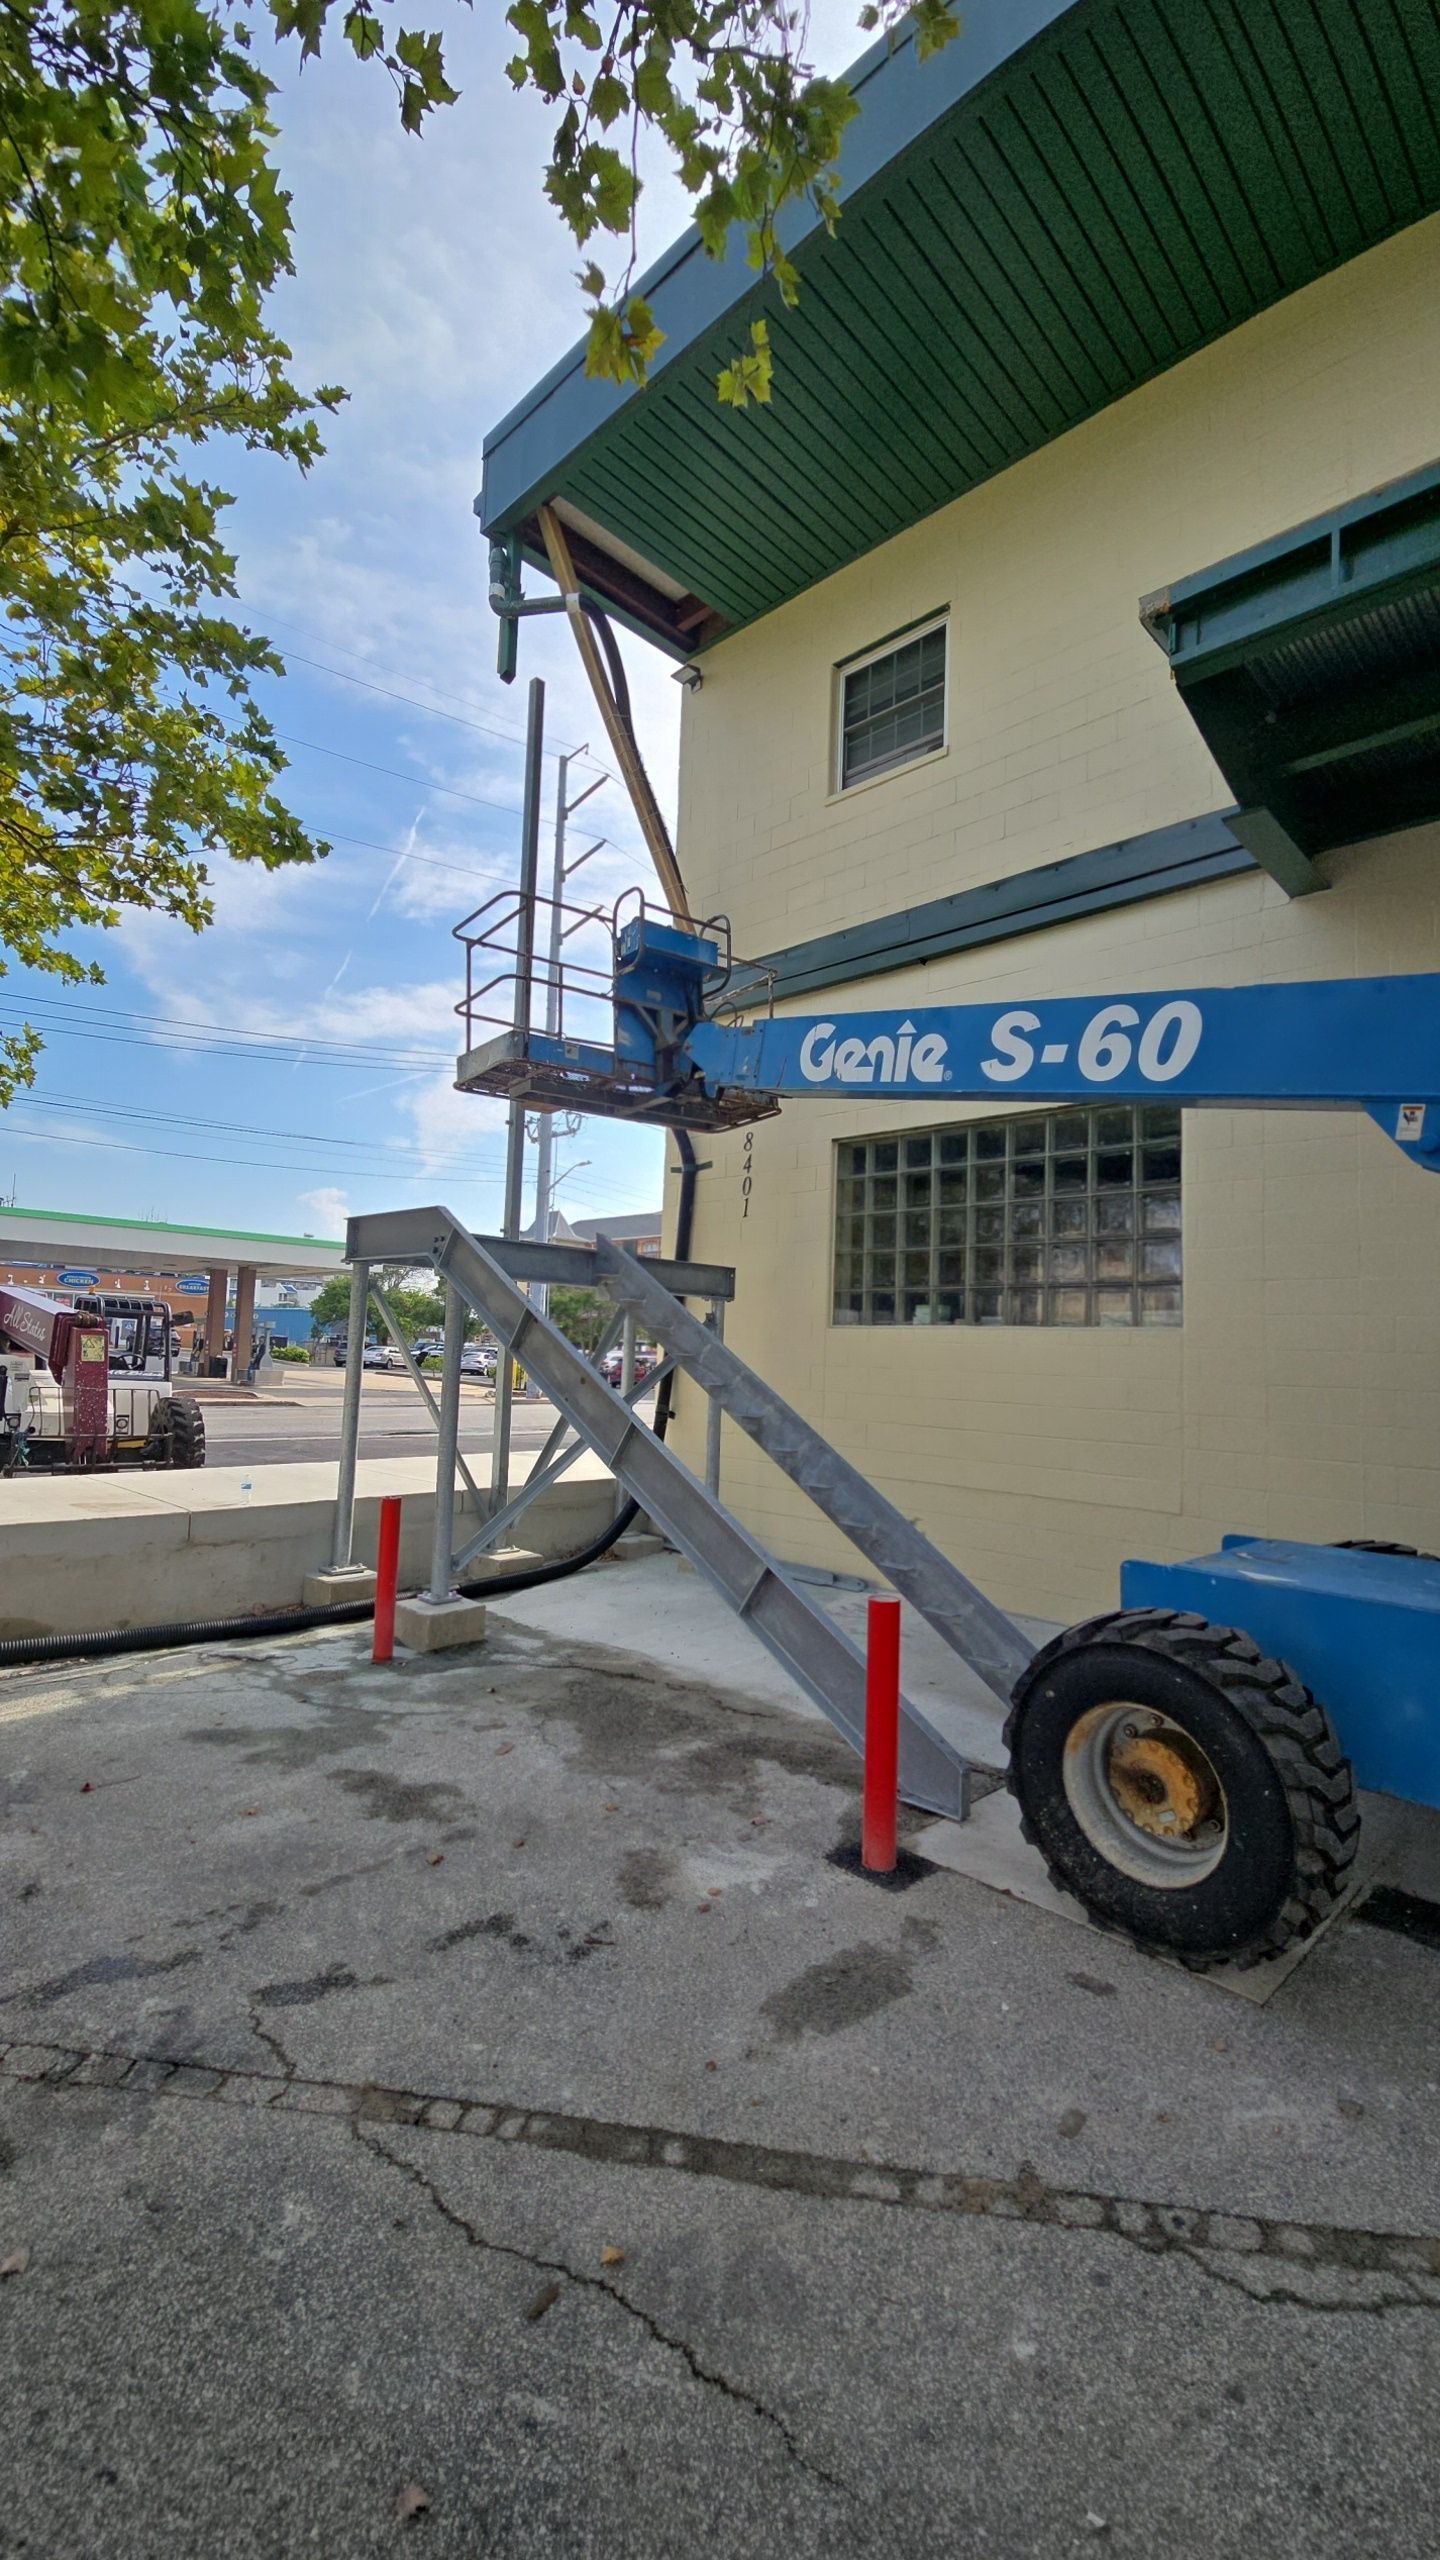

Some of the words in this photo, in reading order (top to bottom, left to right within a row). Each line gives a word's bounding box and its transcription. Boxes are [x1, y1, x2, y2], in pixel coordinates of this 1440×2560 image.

[800, 1019, 949, 1083] Genie
[980, 1000, 1204, 1083] S-60
[742, 1131, 754, 1218] 8401
